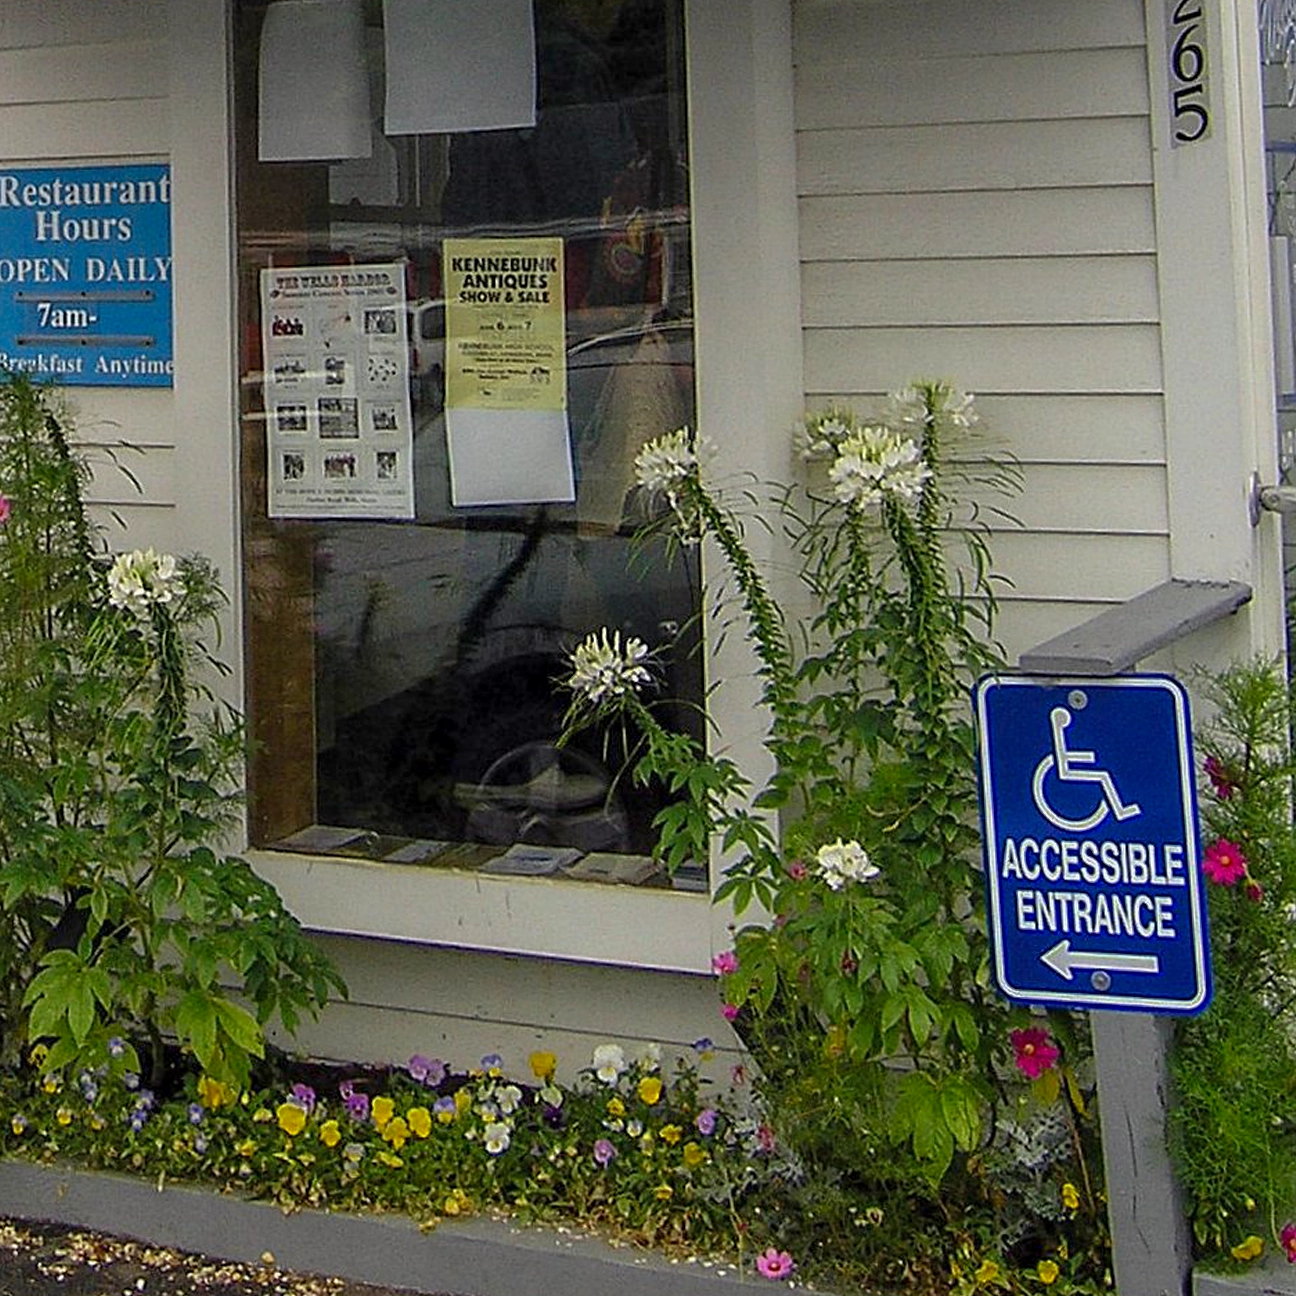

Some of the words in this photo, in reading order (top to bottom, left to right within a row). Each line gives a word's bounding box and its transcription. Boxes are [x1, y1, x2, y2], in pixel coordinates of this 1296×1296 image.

[36, 211, 132, 241] Hours
[86, 256, 173, 283] DAILY
[452, 256, 557, 273] KENNEBUNK
[463, 274, 548, 290] ANTIQUES
[459, 291, 502, 304] SHOW
[504, 291, 514, 304] &
[518, 291, 551, 304] SALE
[37, 302, 98, 328] 7am-
[94, 354, 174, 378] Anytime
[1002, 837, 1186, 886] ACCESSIBLE
[1016, 889, 1177, 938] ENTRANCE
